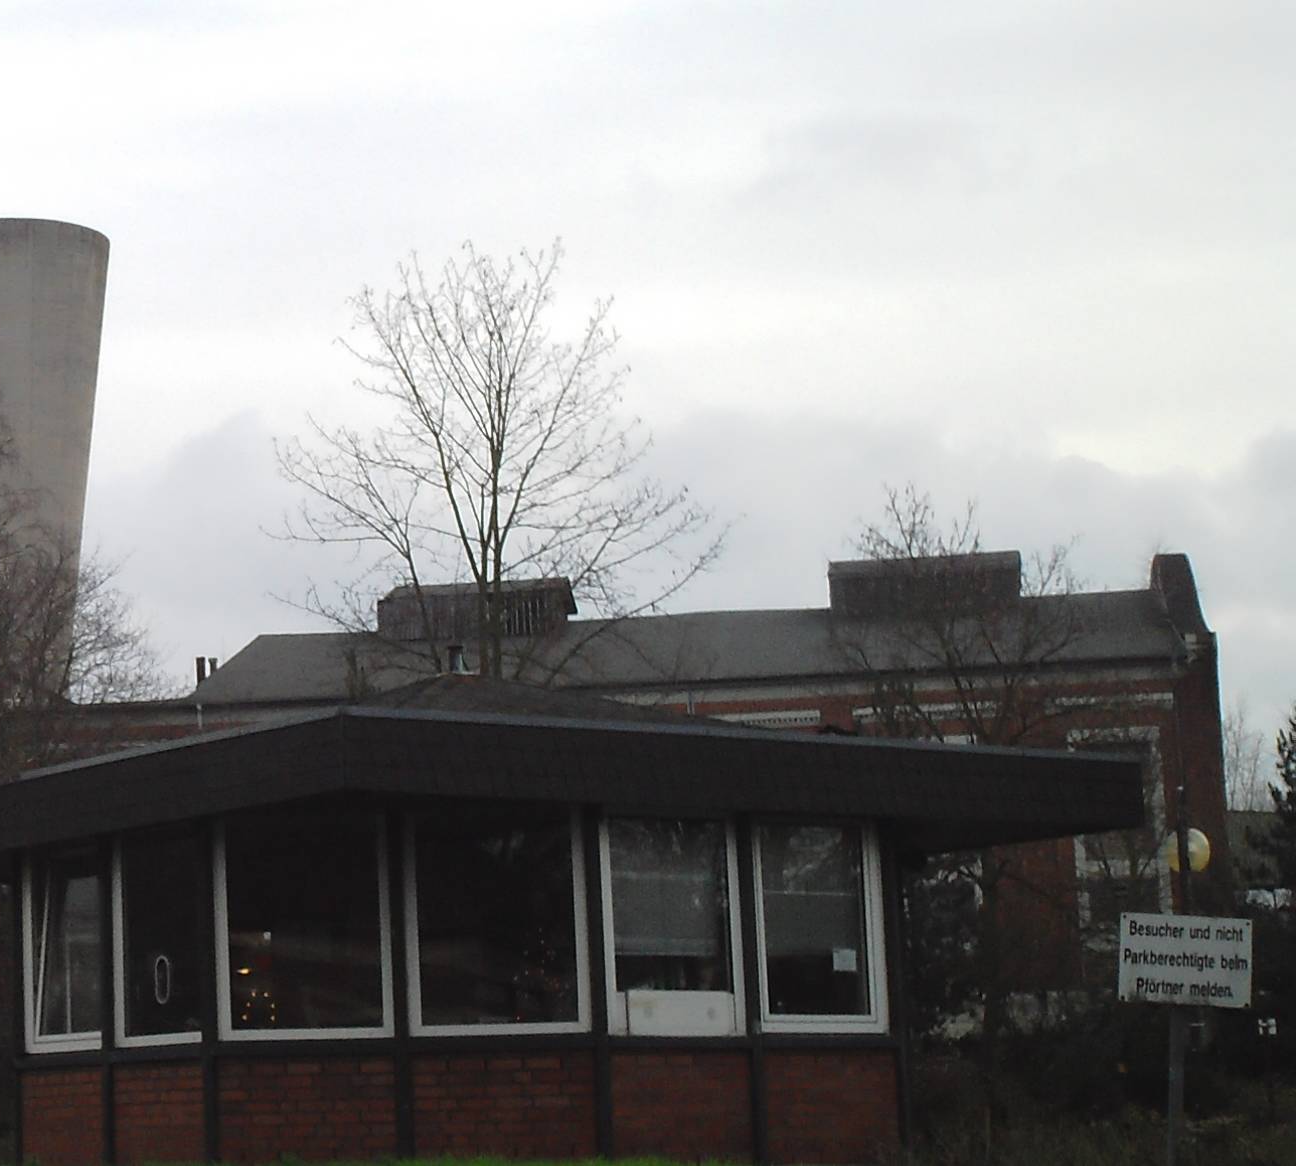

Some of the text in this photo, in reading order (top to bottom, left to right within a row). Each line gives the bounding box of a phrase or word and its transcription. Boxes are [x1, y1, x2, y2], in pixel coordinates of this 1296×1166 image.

[1129, 920, 1243, 942] Besucher und nicht
[1124, 948, 1248, 971] Parkberechtigte beim
[1136, 978, 1184, 997] Pförtner
